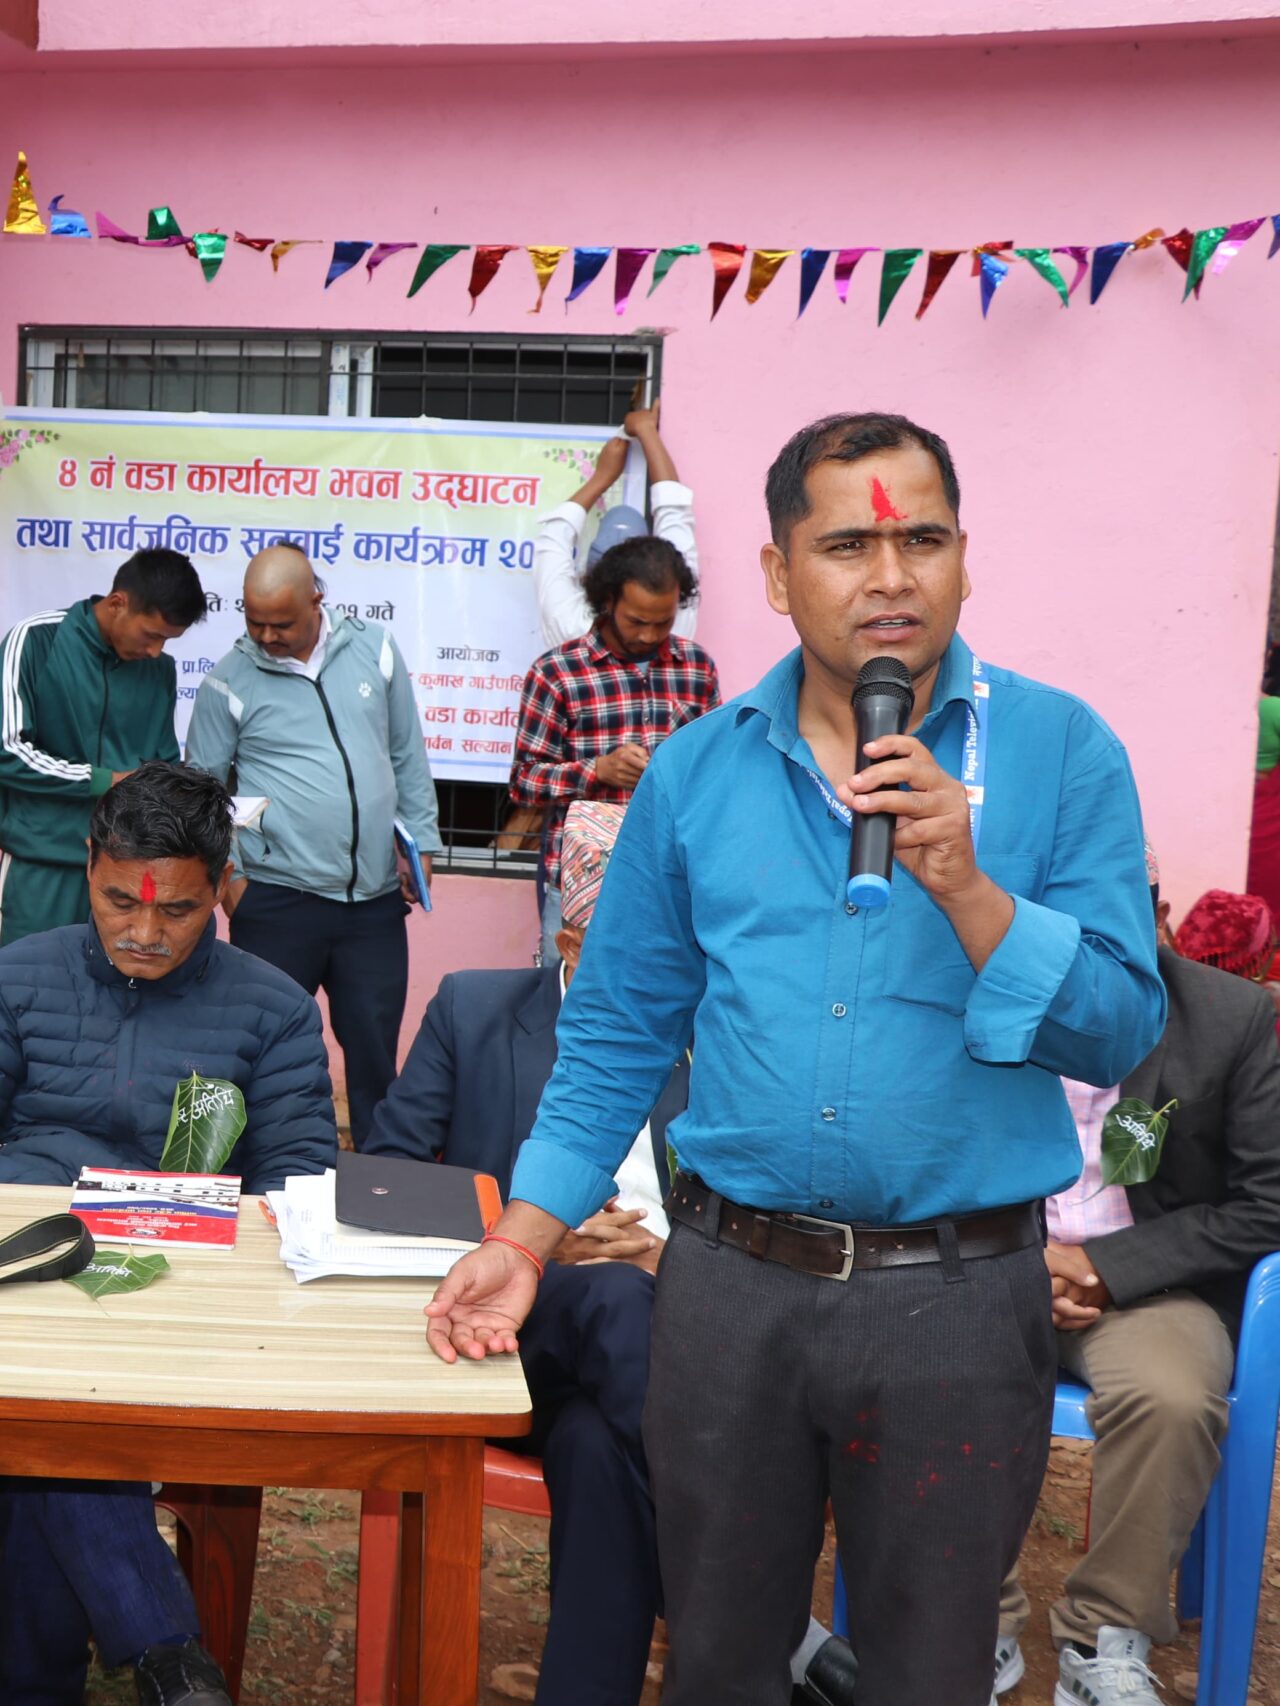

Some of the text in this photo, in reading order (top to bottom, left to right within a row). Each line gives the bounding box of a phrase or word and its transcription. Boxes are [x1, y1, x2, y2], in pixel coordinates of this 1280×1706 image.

[58, 459, 77, 488] ४
[90, 455, 116, 490] नं
[125, 462, 177, 492] वडा
[186, 458, 320, 497] कार्यालय
[329, 468, 403, 500] भवन
[16, 517, 73, 549] तथा
[81, 513, 231, 555] सार्वजनिक
[353, 526, 489, 567] कार्यक्रम
[366, 600, 396, 621] गते
[436, 644, 501, 662] आयोजक
[425, 706, 457, 724] वडा
[461, 738, 513, 754] सल्यान
[964, 698, 980, 781] Nepal Televi
